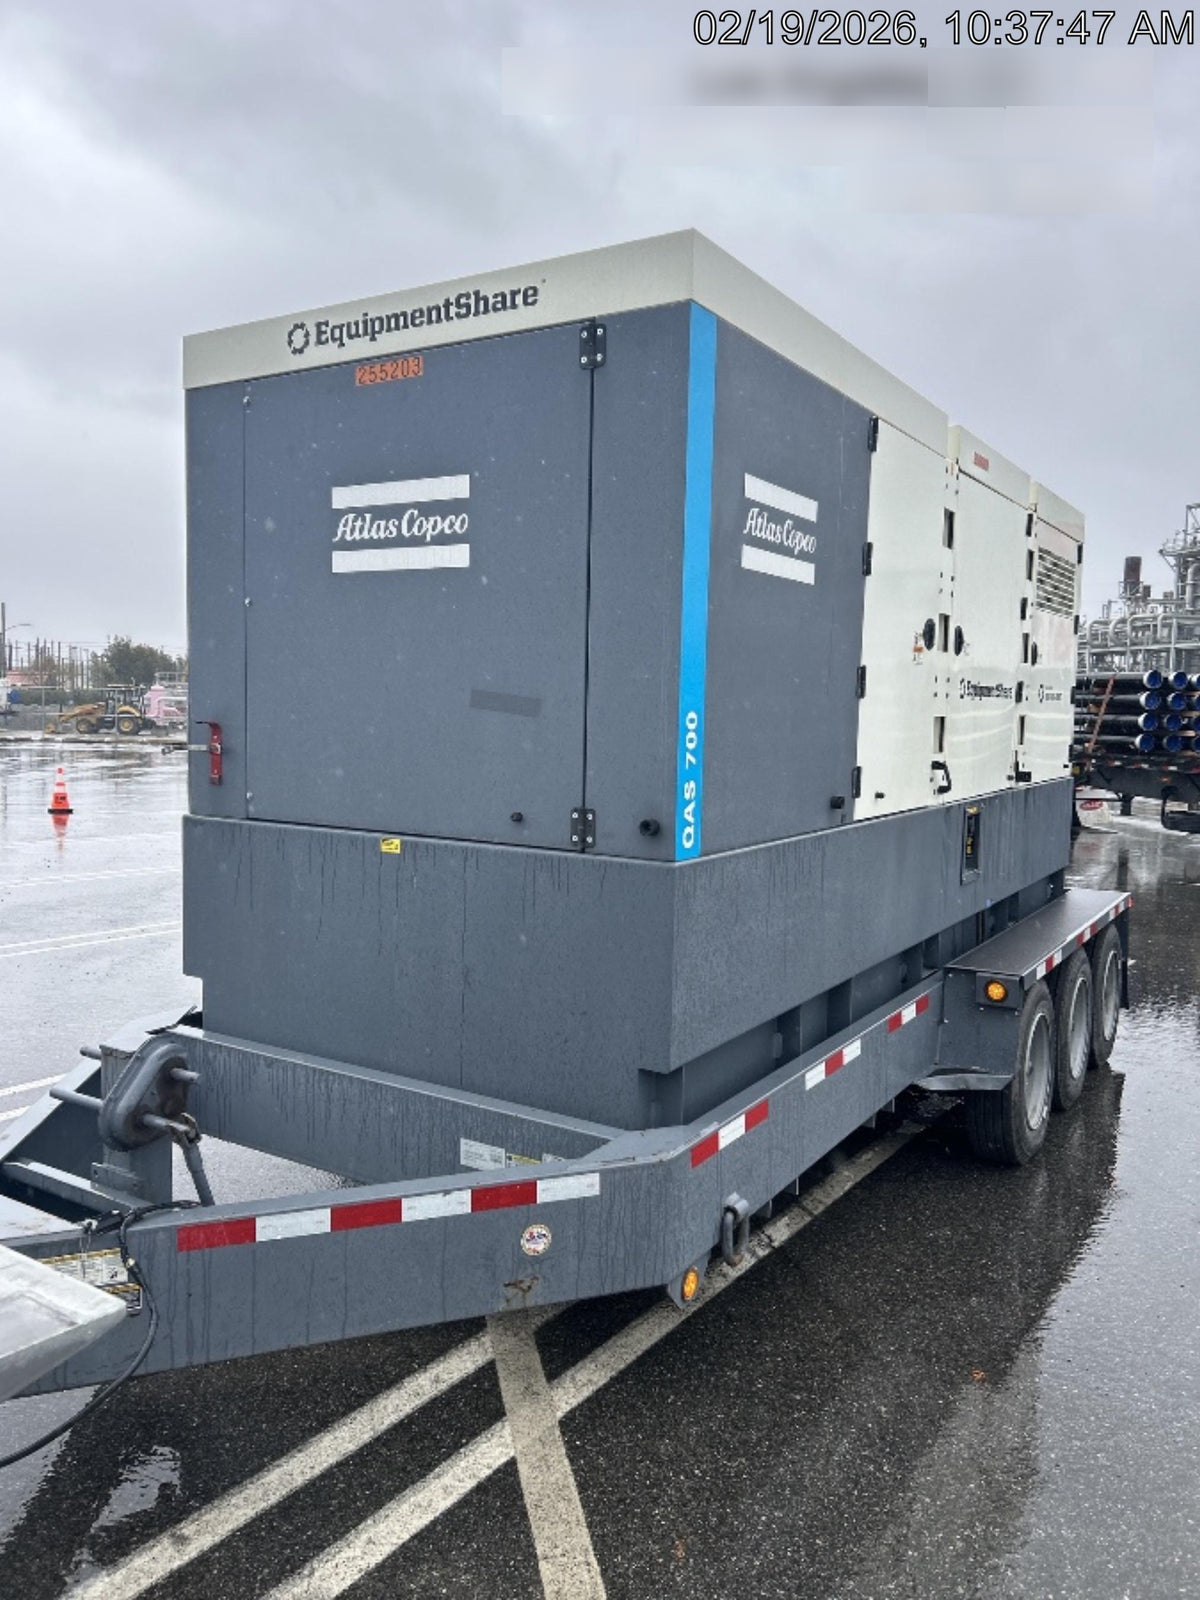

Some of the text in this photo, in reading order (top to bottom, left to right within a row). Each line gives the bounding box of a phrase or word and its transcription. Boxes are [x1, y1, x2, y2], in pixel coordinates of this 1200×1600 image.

[314, 284, 539, 349] EquipmentShare
[357, 355, 423, 385] 255203
[331, 507, 469, 543] Atlas Copco
[743, 507, 817, 556] Atlas Copco
[682, 710, 698, 849] QAS 700
